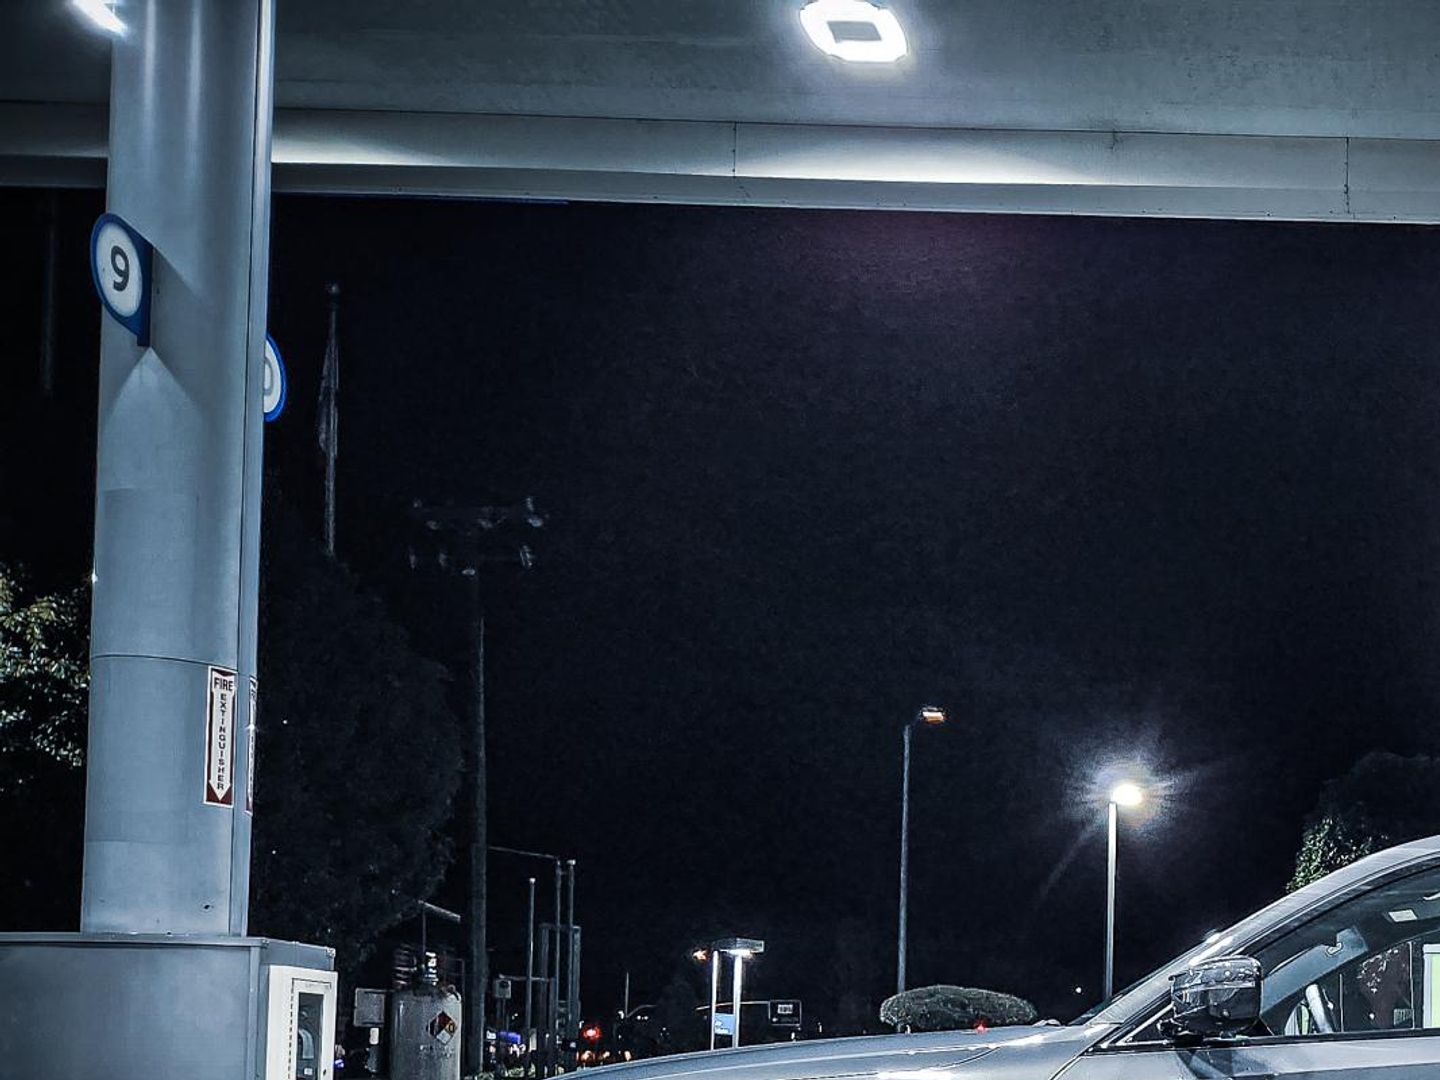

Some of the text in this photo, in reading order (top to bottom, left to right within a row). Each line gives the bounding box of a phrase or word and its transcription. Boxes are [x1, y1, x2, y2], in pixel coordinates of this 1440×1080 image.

[109, 244, 131, 293] 9
[213, 677, 235, 692] FIRE
[216, 692, 227, 791] EXTINGUISHER
